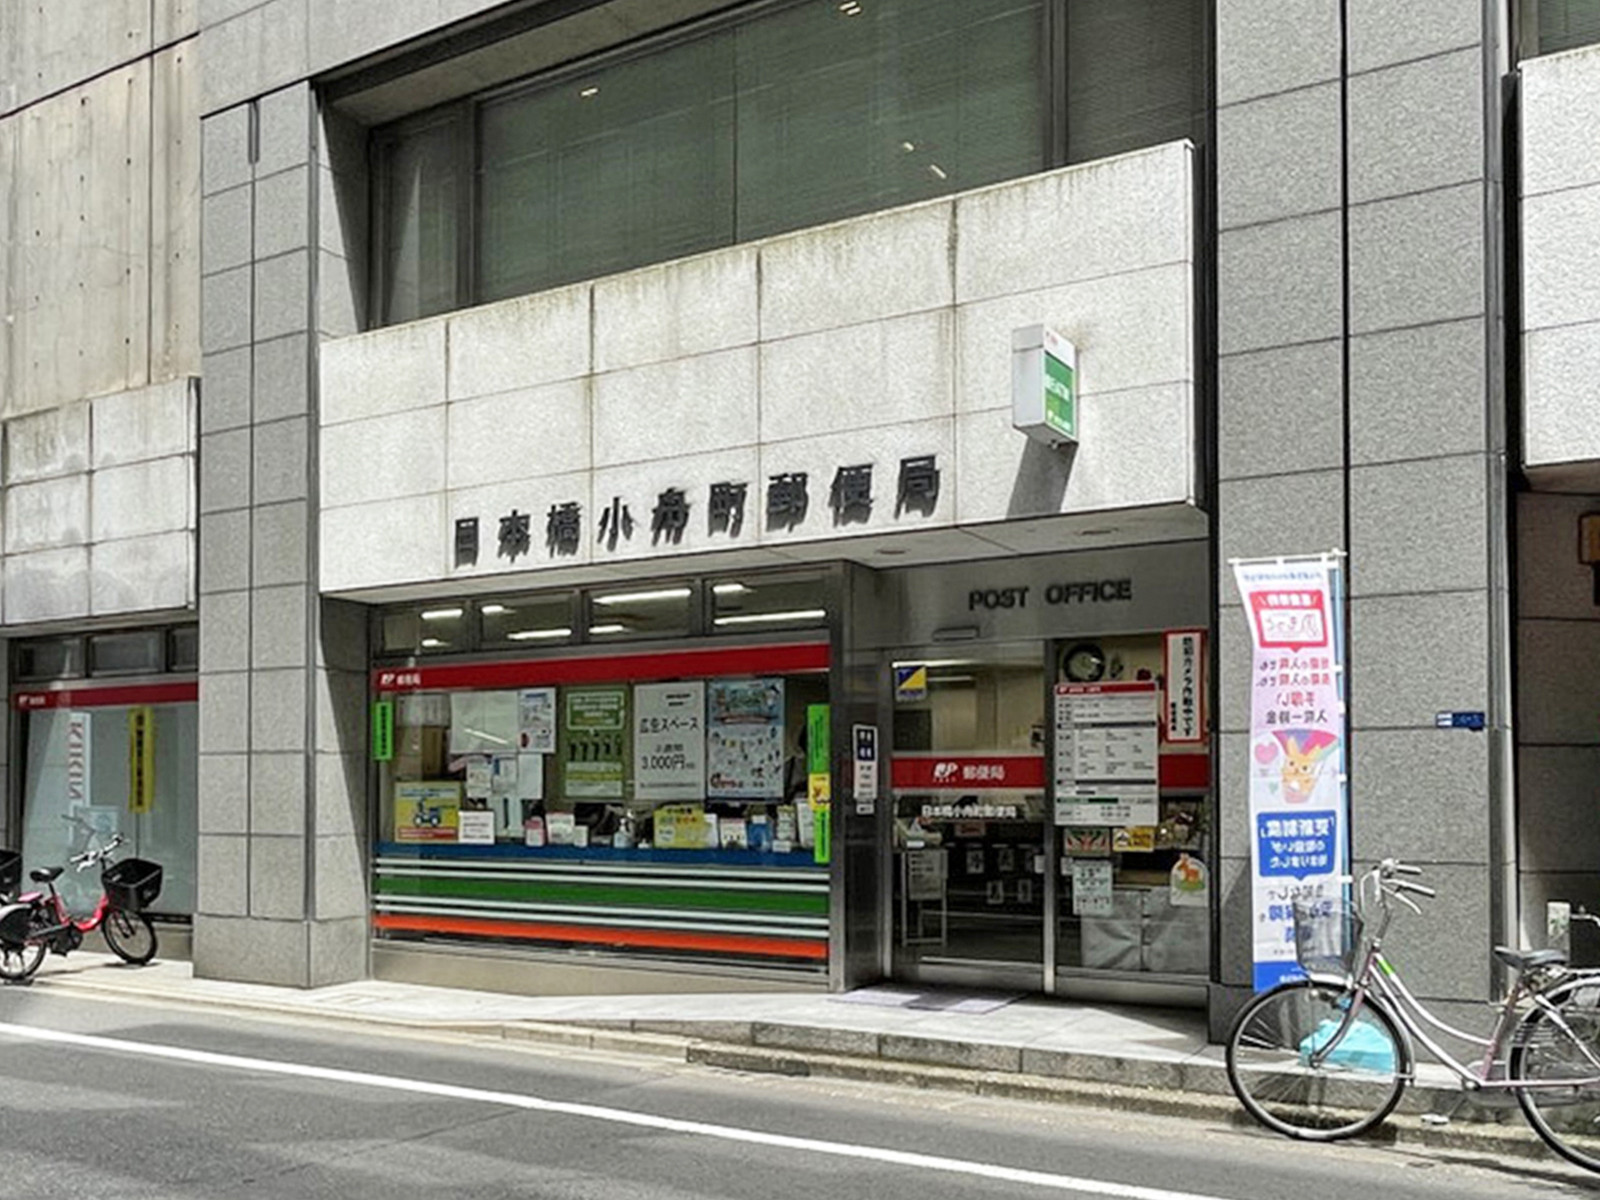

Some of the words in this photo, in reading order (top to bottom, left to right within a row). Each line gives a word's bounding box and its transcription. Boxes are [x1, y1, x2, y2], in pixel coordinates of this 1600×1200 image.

[455, 454, 941, 565] 日本橋小舟町郵便局
[968, 586, 1030, 611] POST
[1044, 578, 1132, 605] OFFICE
[962, 765, 1006, 781] 郵便局
